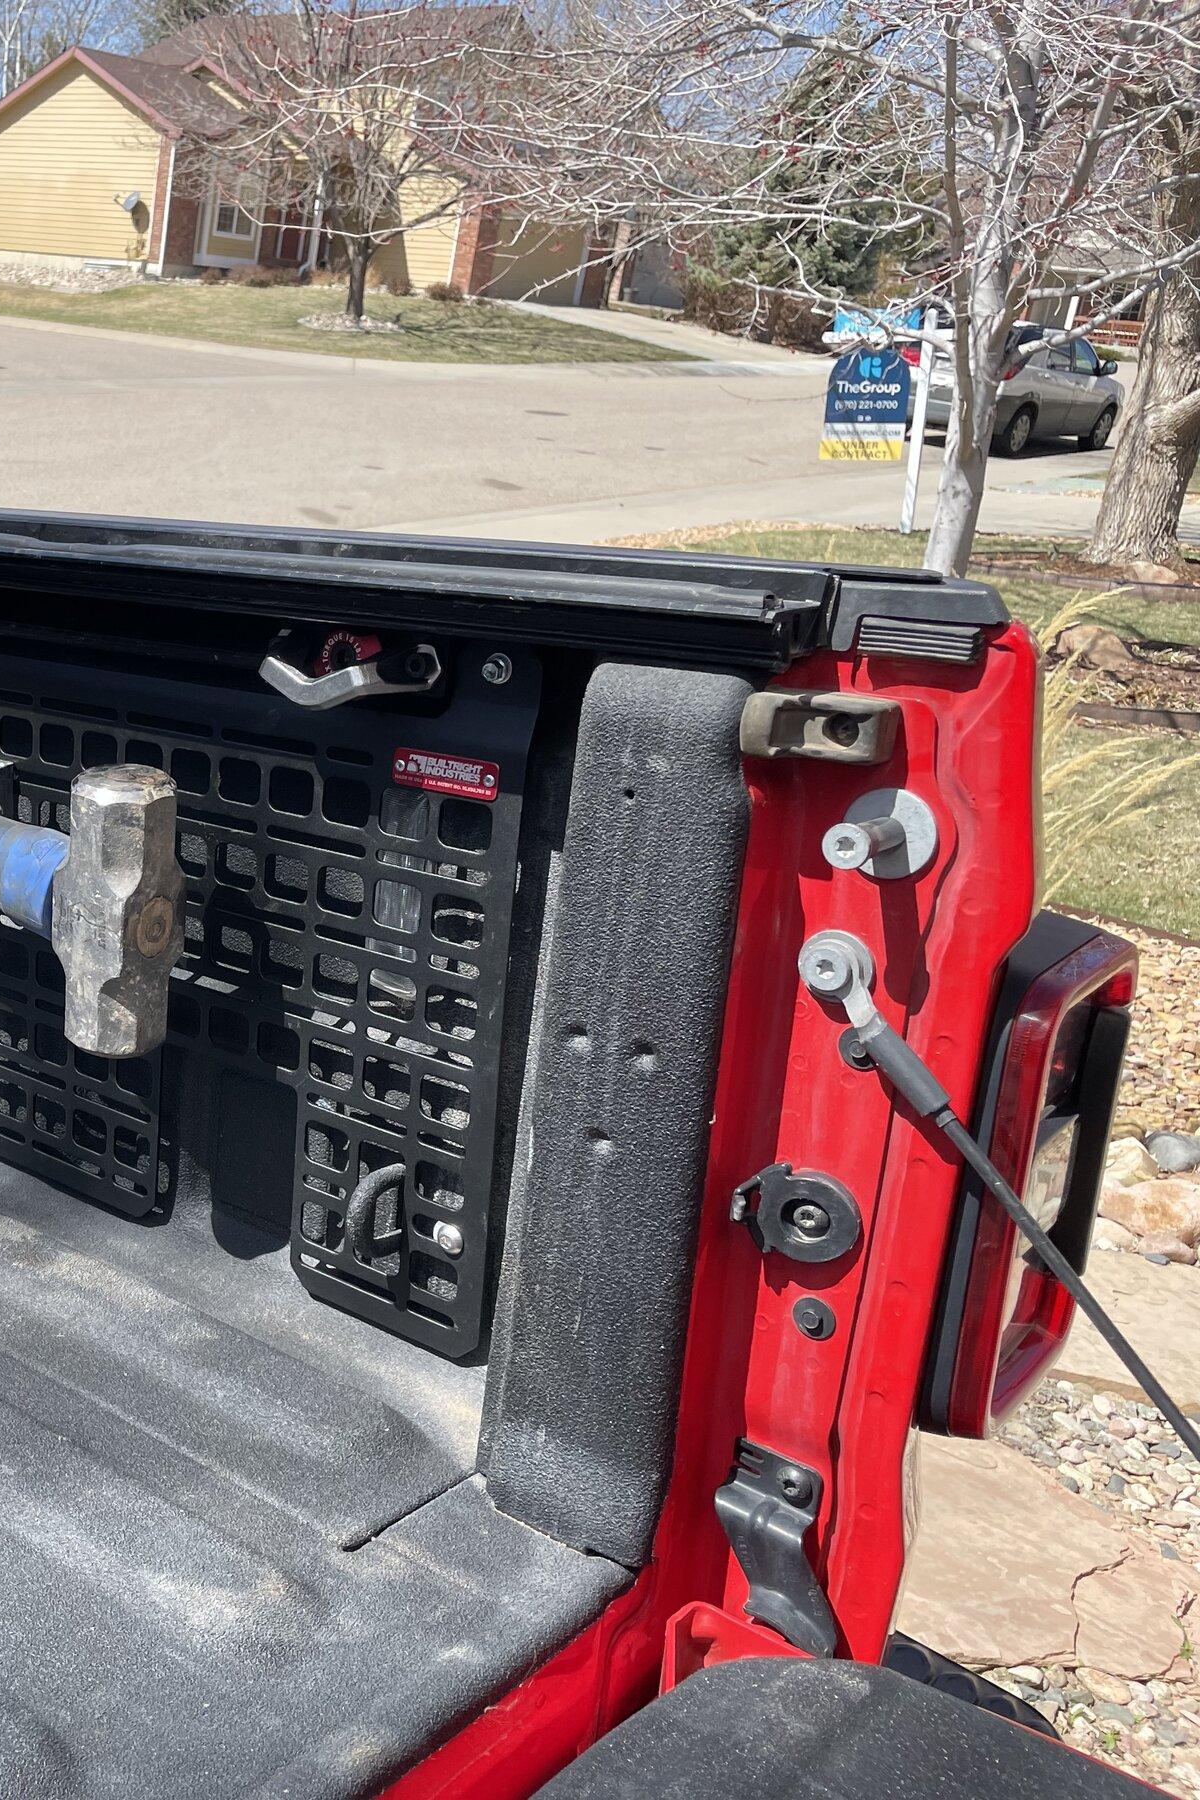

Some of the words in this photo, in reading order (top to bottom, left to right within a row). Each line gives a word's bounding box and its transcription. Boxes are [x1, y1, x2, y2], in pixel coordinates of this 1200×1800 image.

[836, 380, 901, 396] TheGroup
[859, 400, 899, 410] 221-0700
[843, 441, 879, 449] UNDER
[831, 450, 887, 459] CONTRACT
[322, 632, 343, 663] TORQUE
[427, 757, 484, 774] BUILTRIGHT
[425, 765, 481, 783] INDUSTRIES
